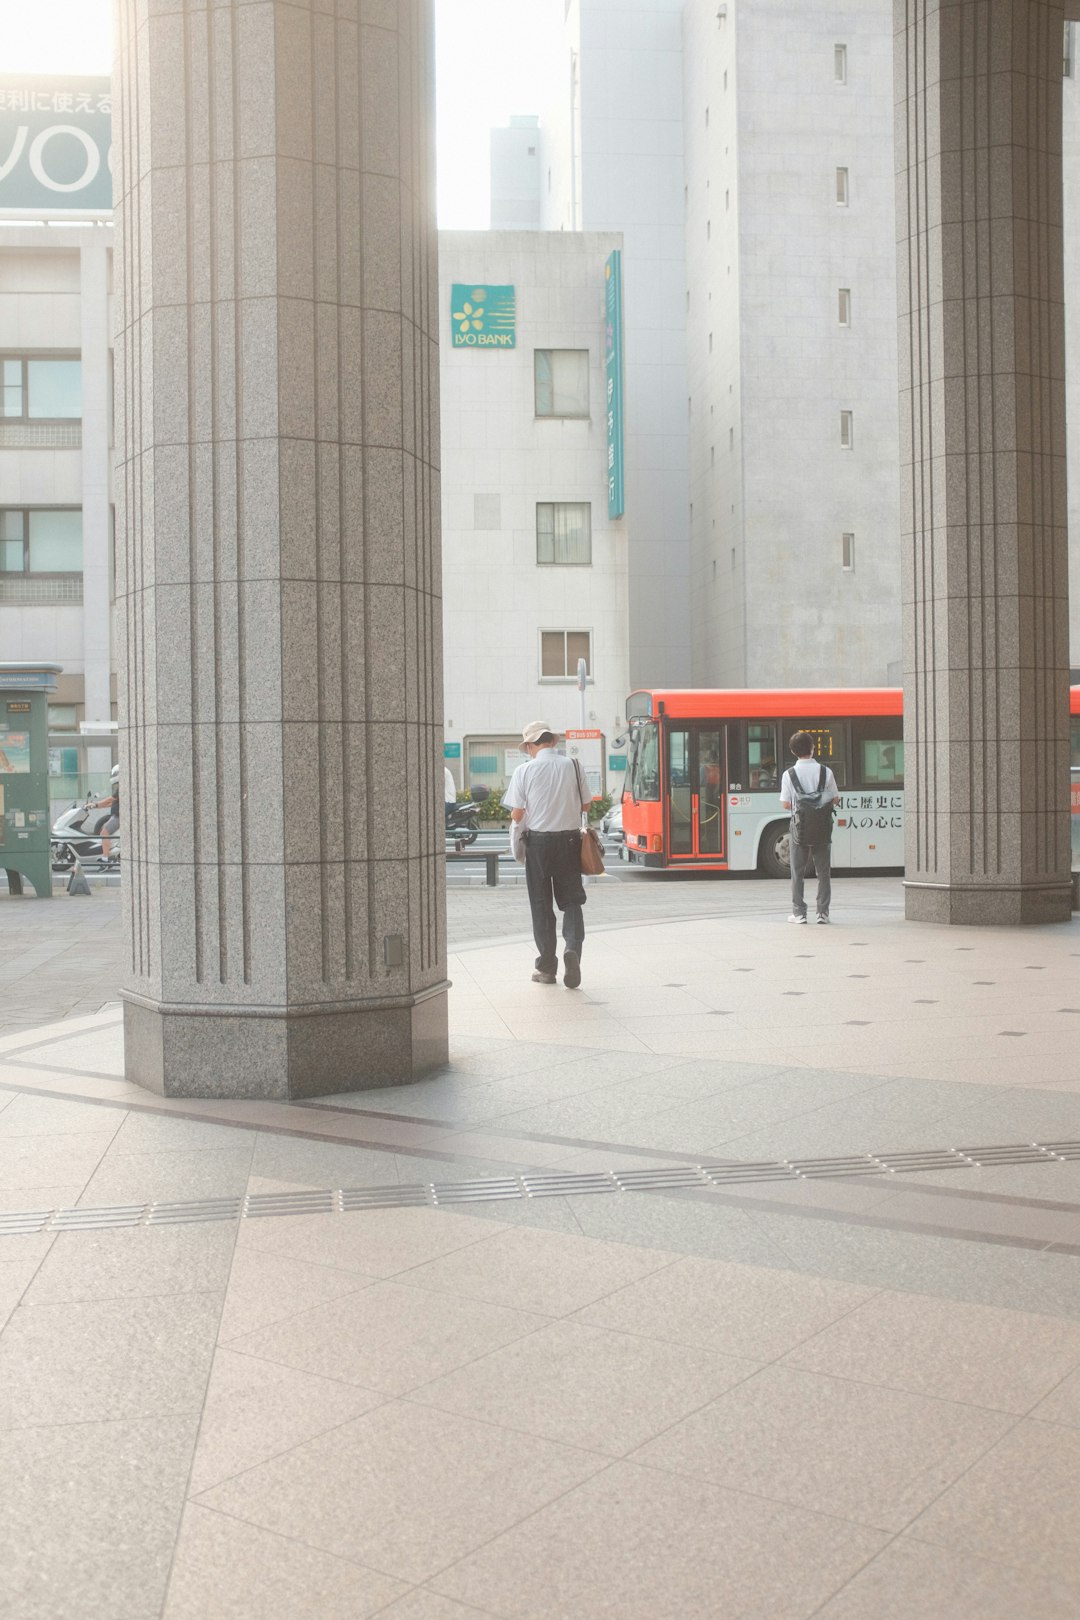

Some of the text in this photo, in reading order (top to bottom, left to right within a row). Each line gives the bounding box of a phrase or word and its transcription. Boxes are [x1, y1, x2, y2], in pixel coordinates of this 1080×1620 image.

[455, 333, 513, 345] IYO BANK
[847, 816, 902, 829] 人の心に
